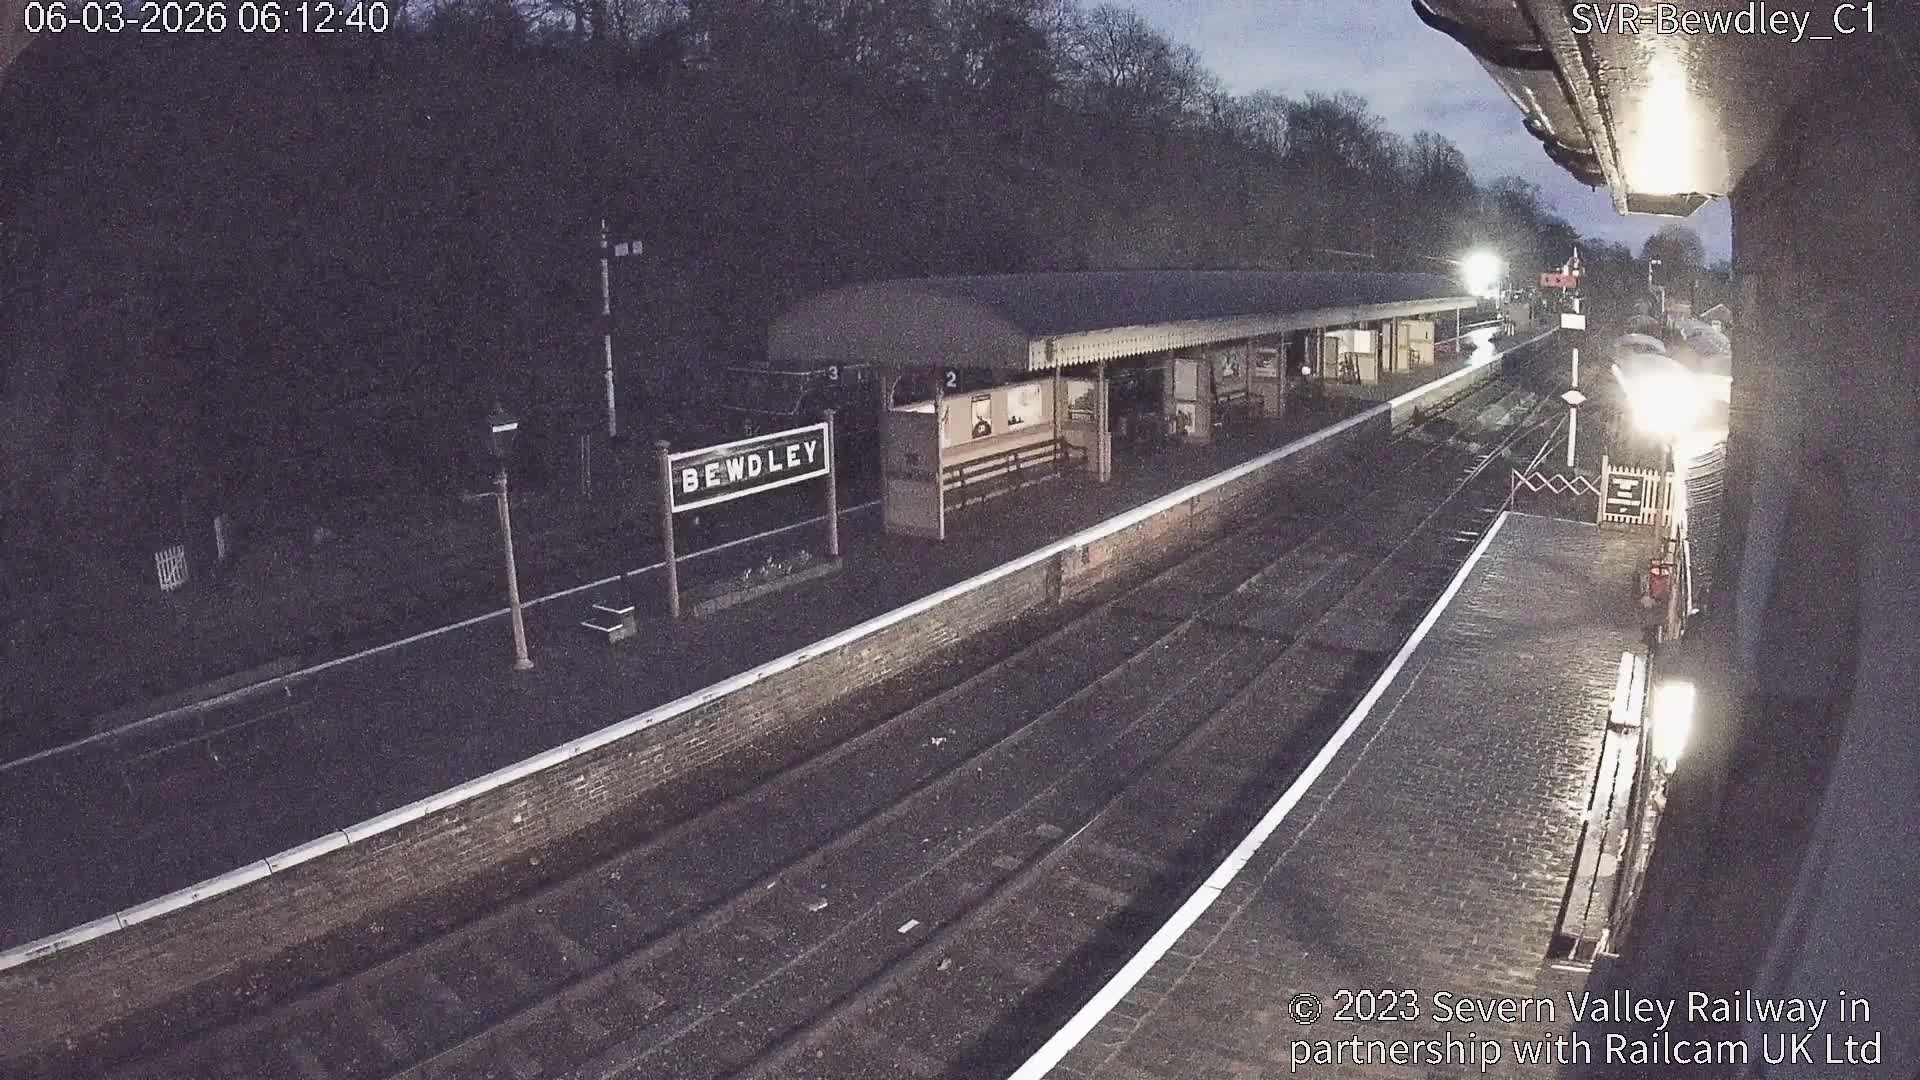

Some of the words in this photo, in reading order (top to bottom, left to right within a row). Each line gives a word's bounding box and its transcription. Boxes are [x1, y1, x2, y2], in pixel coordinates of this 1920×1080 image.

[828, 366, 839, 380] 3
[946, 371, 957, 387] 2
[683, 440, 816, 493] BEWDLEY
